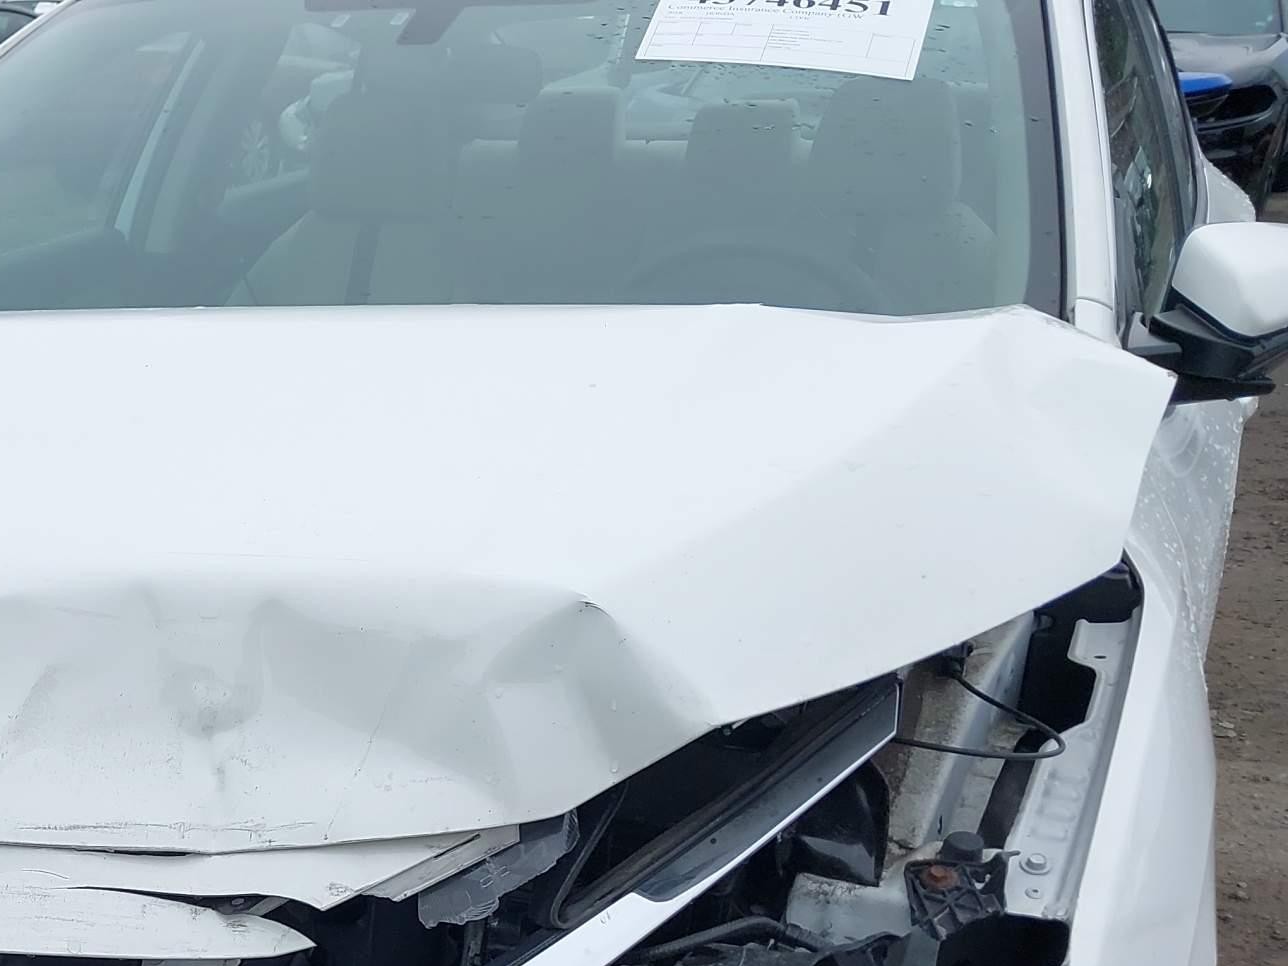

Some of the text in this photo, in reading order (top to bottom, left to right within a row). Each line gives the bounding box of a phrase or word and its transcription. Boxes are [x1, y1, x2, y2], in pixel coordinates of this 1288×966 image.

[696, 0, 892, 16] 6451
[728, 6, 780, 14] Insurance
[782, 8, 834, 17] Company
